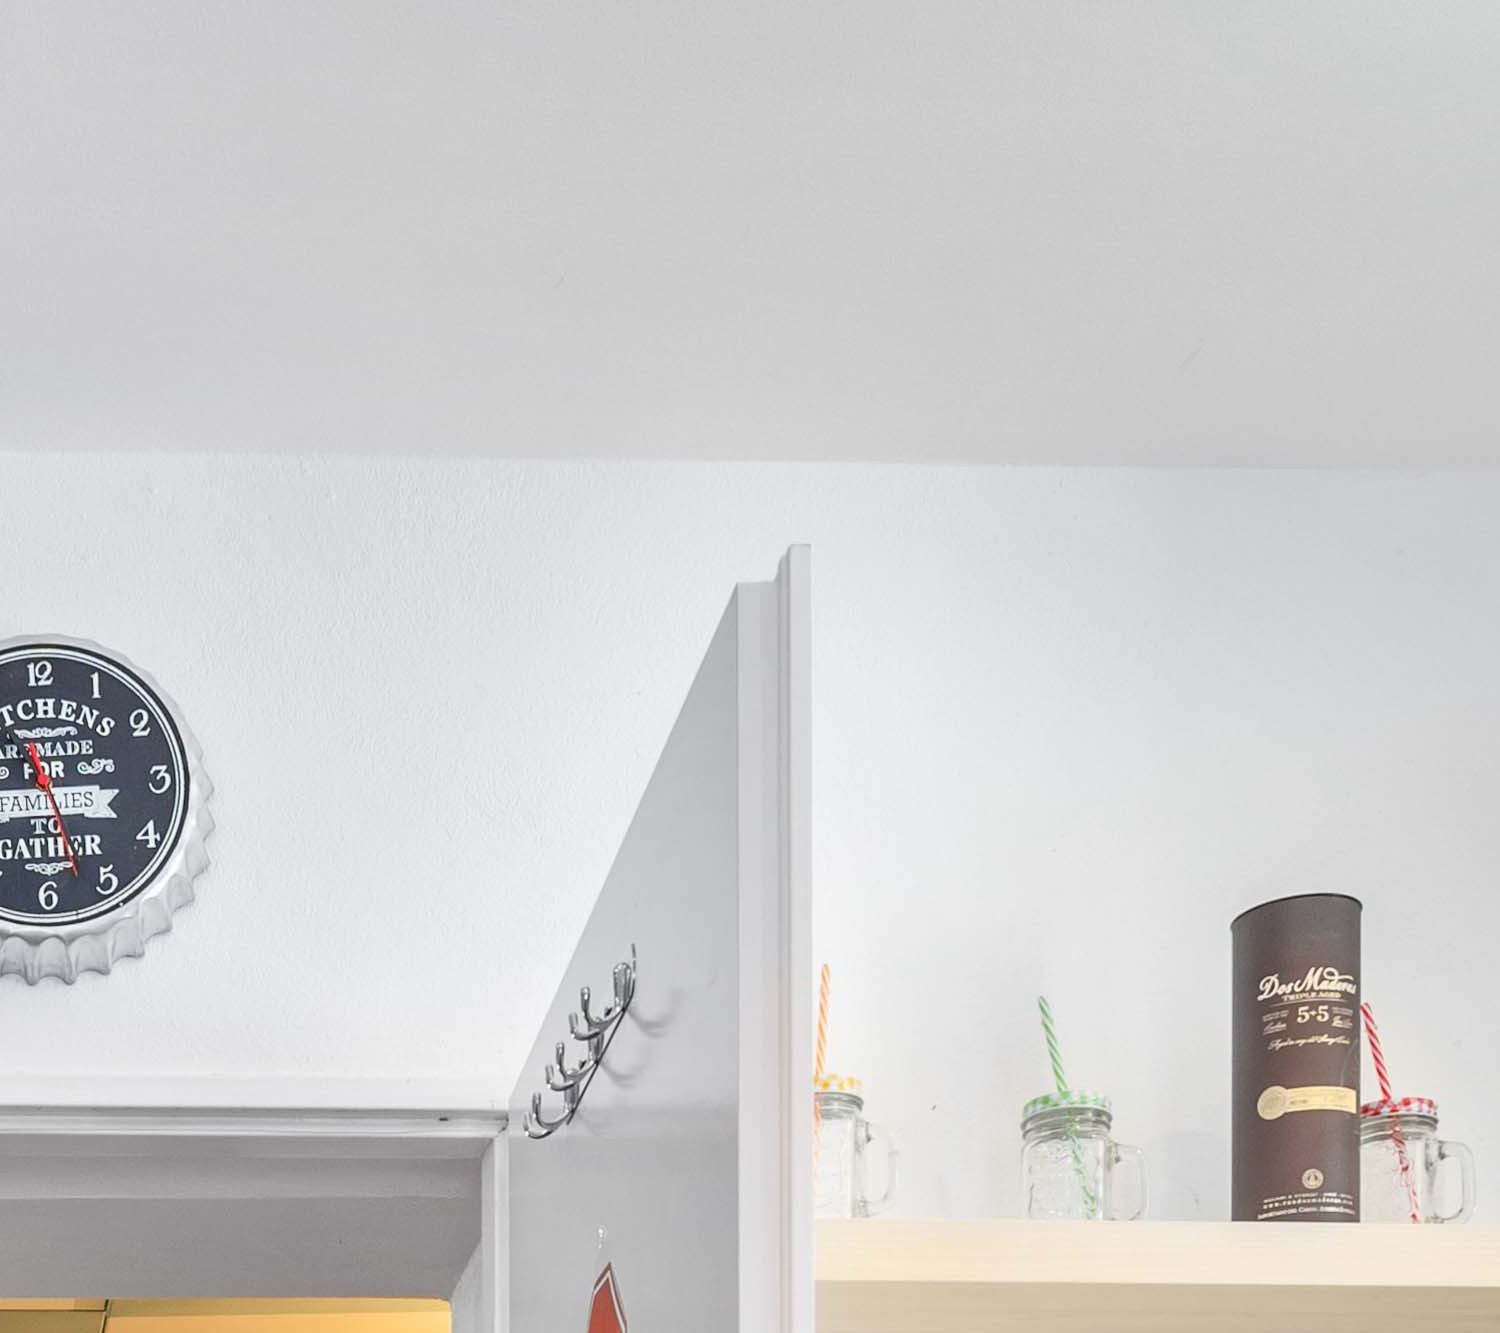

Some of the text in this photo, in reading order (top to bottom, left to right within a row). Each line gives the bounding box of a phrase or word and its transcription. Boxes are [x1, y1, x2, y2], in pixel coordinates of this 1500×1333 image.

[27, 661, 53, 686] 12
[91, 672, 101, 698] 1
[129, 709, 151, 737] 2
[35, 739, 94, 757] MADE
[148, 765, 171, 793] 3
[30, 818, 61, 834] TO
[136, 820, 160, 849] 4
[96, 864, 118, 895] 5
[38, 881, 58, 910] 6
[1257, 973, 1295, 1001] Dos
